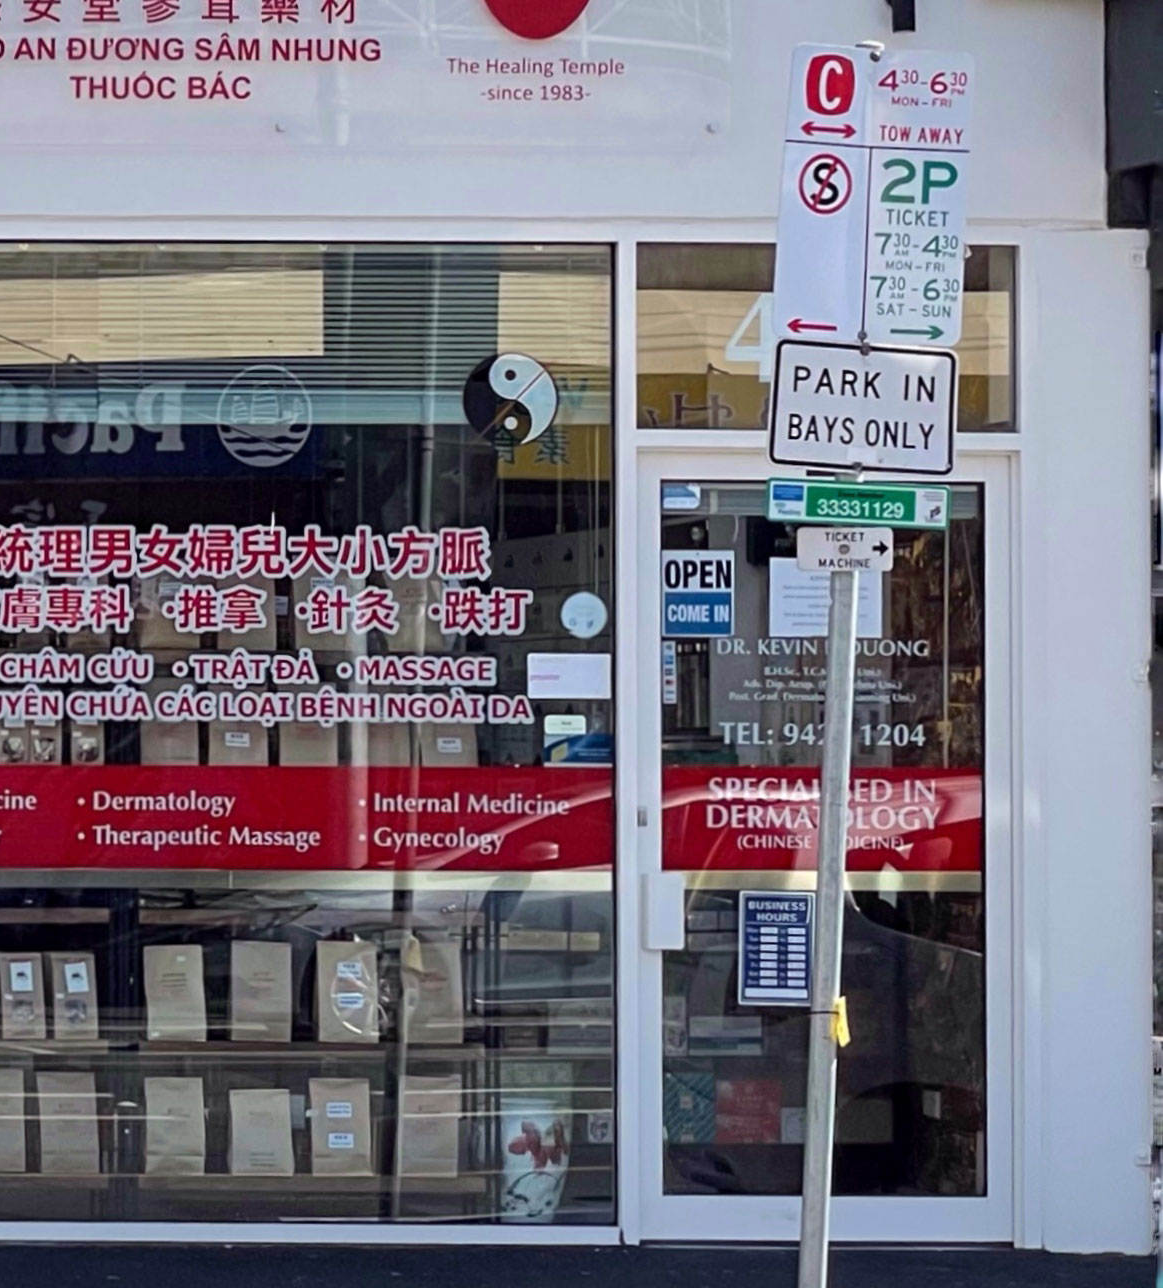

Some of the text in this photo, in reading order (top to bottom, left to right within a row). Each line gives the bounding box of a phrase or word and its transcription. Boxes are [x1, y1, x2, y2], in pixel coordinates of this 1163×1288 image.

[14, 37, 57, 61] AN
[66, 36, 185, 62] ĐƯƠNG
[194, 32, 260, 62] SÂM
[271, 37, 382, 62] NHUNG
[447, 58, 625, 78] The Healing Temple
[187, 72, 251, 100] BÁC
[880, 125, 963, 144] TOW AWAY
[880, 158, 958, 204] 2P
[886, 209, 950, 227] TICKET
[793, 365, 936, 403] PARK IN
[788, 413, 934, 450] BAYS ONLY
[817, 499, 904, 519] 33331129
[824, 531, 866, 542] TICKET
[665, 560, 732, 589] OPEN
[818, 558, 871, 569] MACHINE
[442, 590, 530, 633] 跌打
[667, 604, 729, 623] COME IN
[716, 639, 751, 655] DR.
[758, 638, 818, 656] KEVIN
[359, 659, 493, 681] MASSAGE
[158, 687, 212, 717] CÁC
[492, 698, 530, 720] DA
[719, 722, 926, 747] TEL: 942 1204
[708, 777, 936, 803] SPECIAED IN
[92, 791, 236, 817] Dermatology
[373, 793, 570, 816] Internal Medicine
[706, 804, 940, 830] DERMALOGY
[92, 825, 321, 853] Therapeutic Massage
[373, 827, 504, 854] Gynecology
[737, 834, 812, 850] (CHINESE
[748, 900, 806, 911] BUSINESS
[756, 913, 798, 922] HOURS
